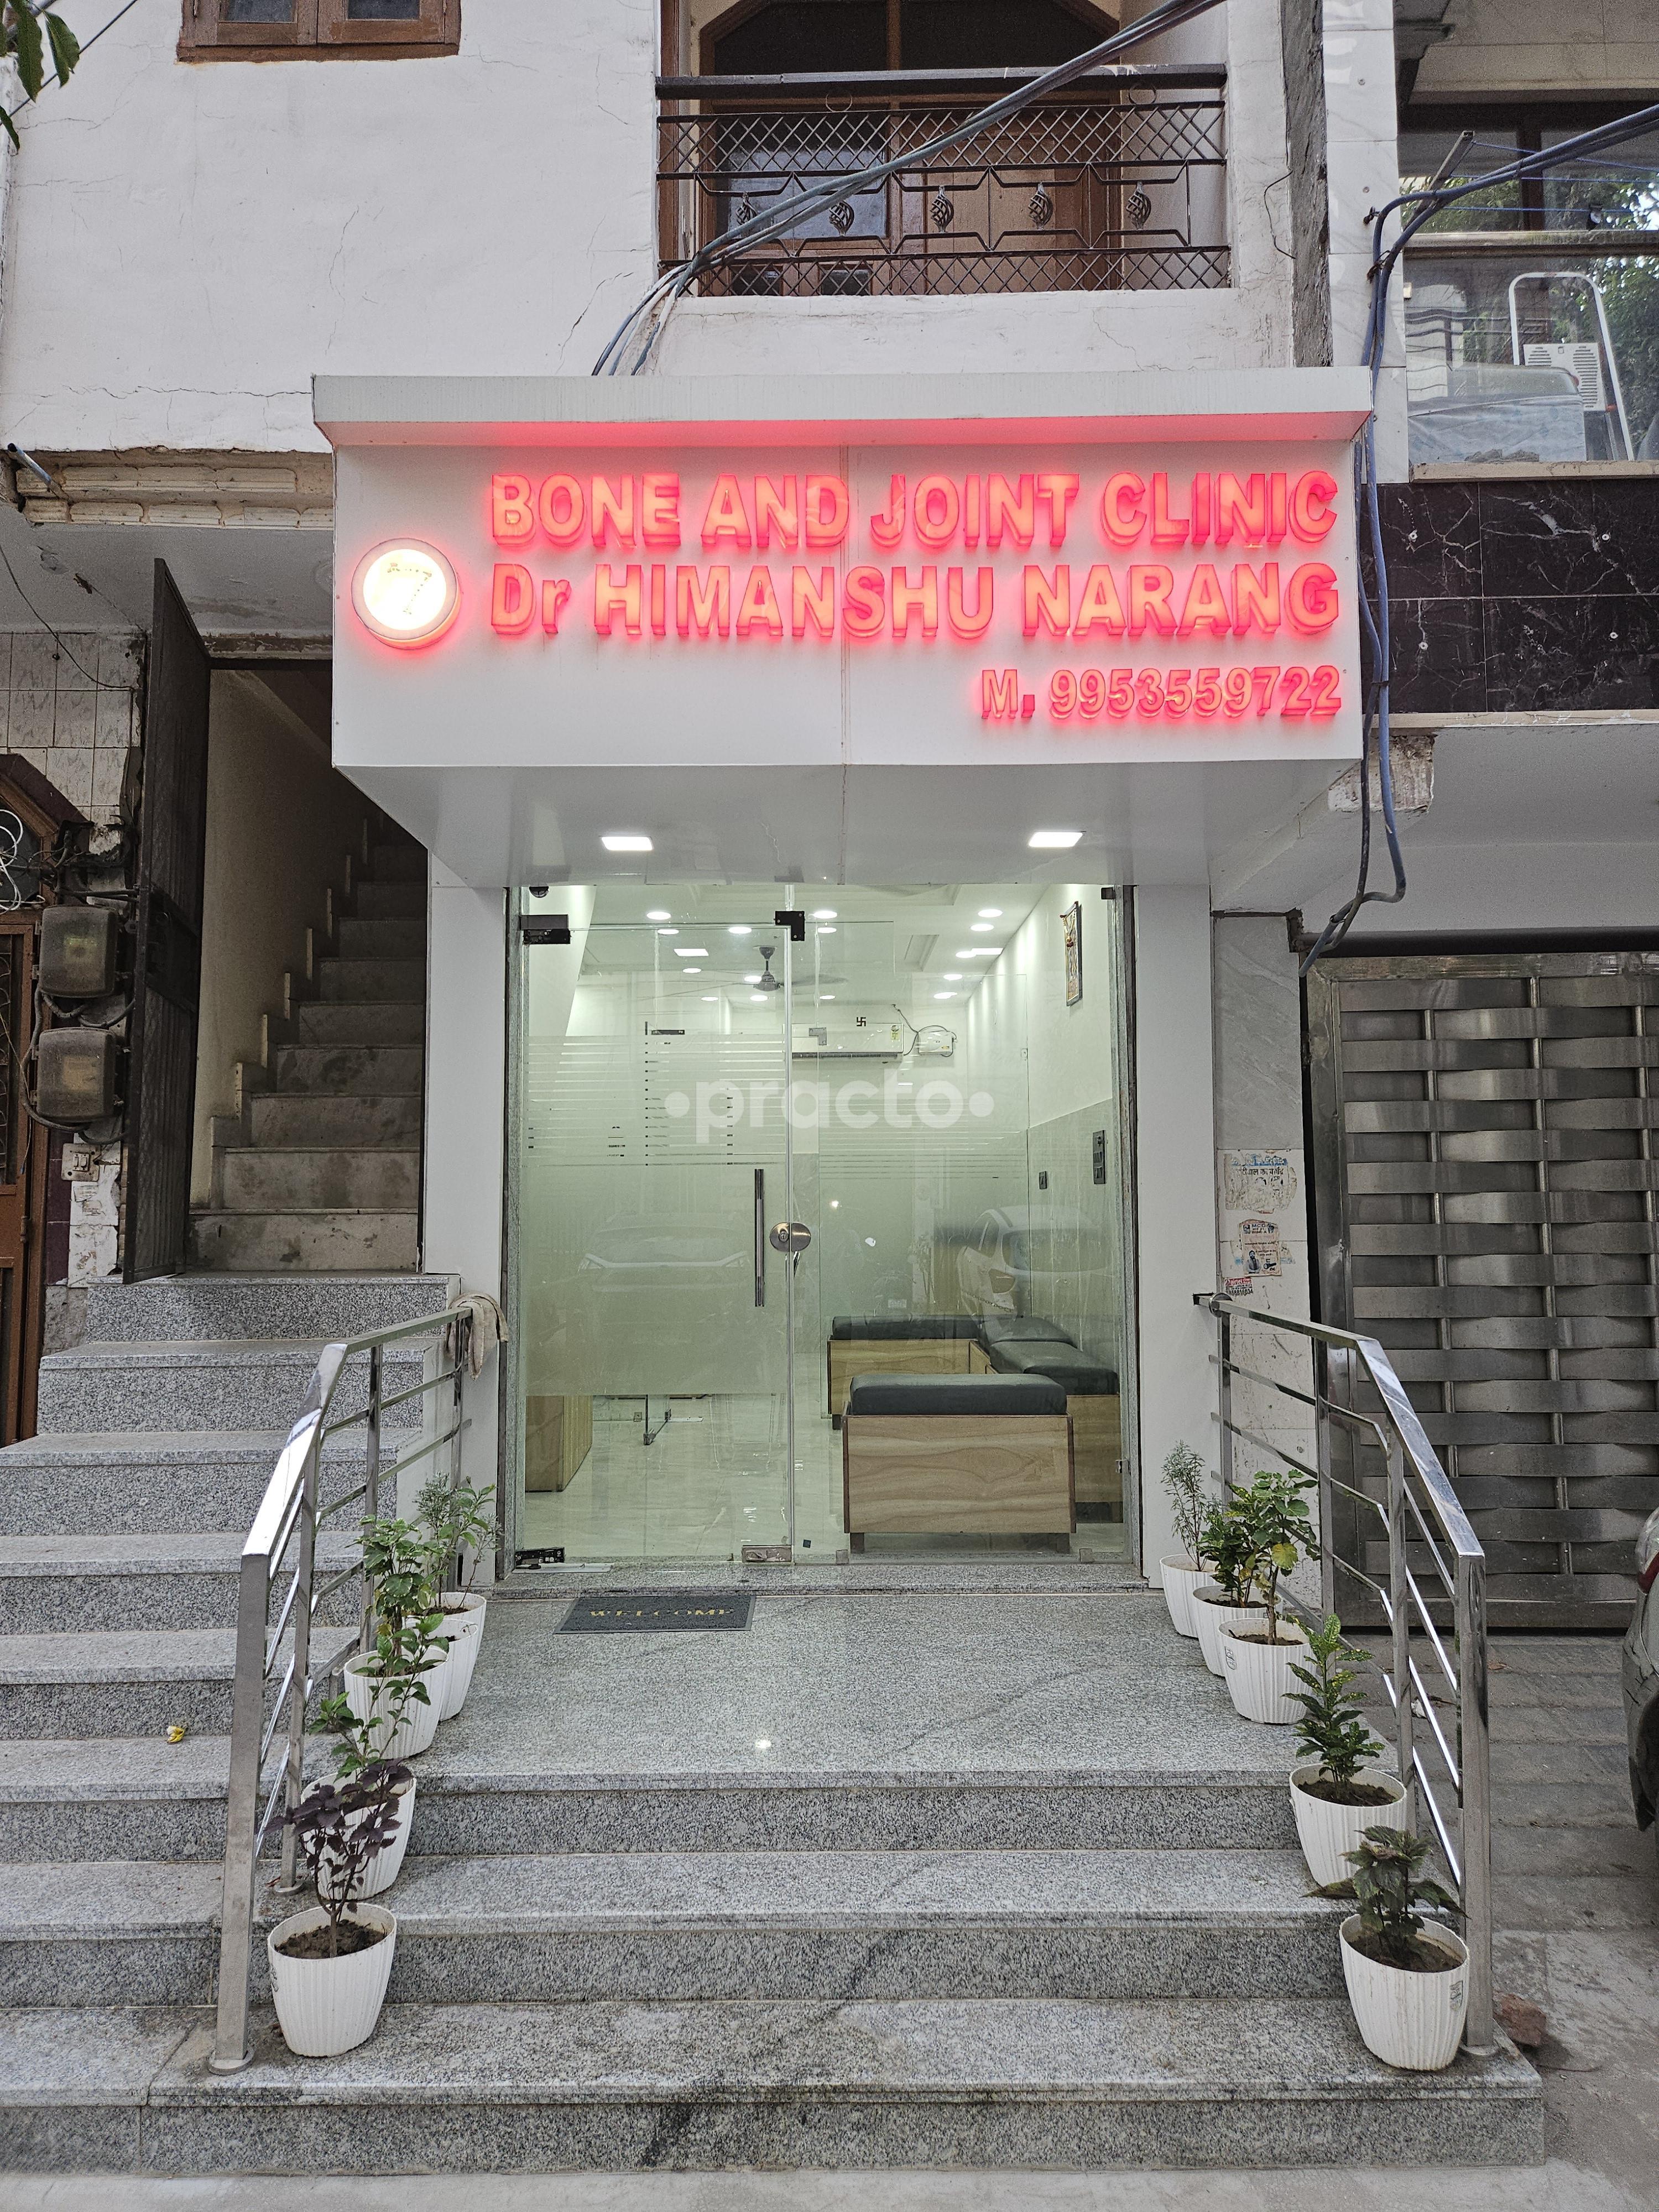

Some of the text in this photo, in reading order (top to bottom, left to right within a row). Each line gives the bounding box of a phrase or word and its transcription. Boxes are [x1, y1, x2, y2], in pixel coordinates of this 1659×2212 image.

[492, 470, 1338, 547] BONE AND JOINT CLINIC
[491, 562, 1339, 638] Dr HIMANSHU NARANG
[981, 665, 1342, 719] M. 9953559722
